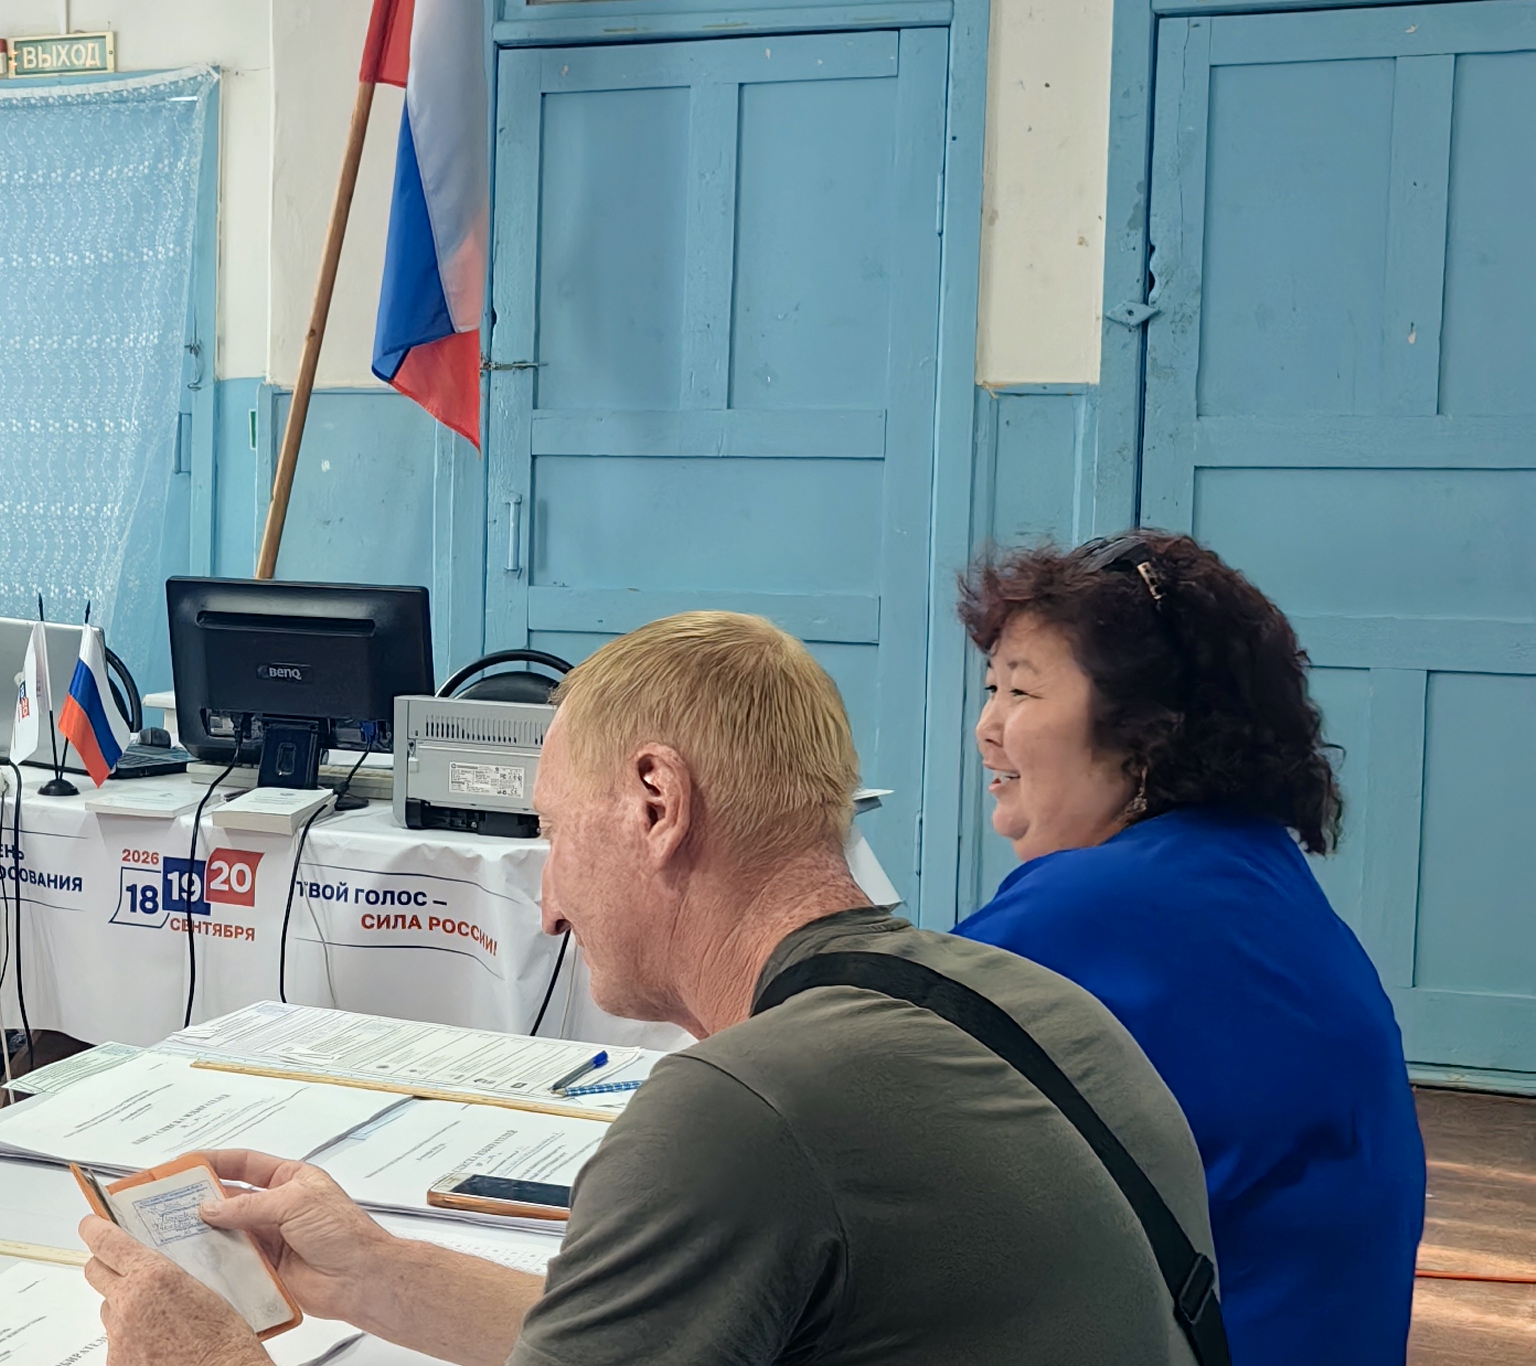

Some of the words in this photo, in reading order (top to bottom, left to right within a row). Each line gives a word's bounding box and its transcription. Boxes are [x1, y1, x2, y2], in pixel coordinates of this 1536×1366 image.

[22, 41, 101, 69] ВЫХОД
[268, 667, 302, 681] BenQ
[121, 848, 160, 866] 2026
[125, 883, 159, 915] 18
[167, 871, 202, 903] 19
[210, 860, 253, 894] 20
[295, 880, 349, 904] ТВОЙ
[354, 888, 428, 907] ГОЛОС
[170, 917, 255, 942] СЕНТЯБРЯ
[361, 913, 422, 931] СИЛА
[428, 915, 498, 957] РОССИИ!
